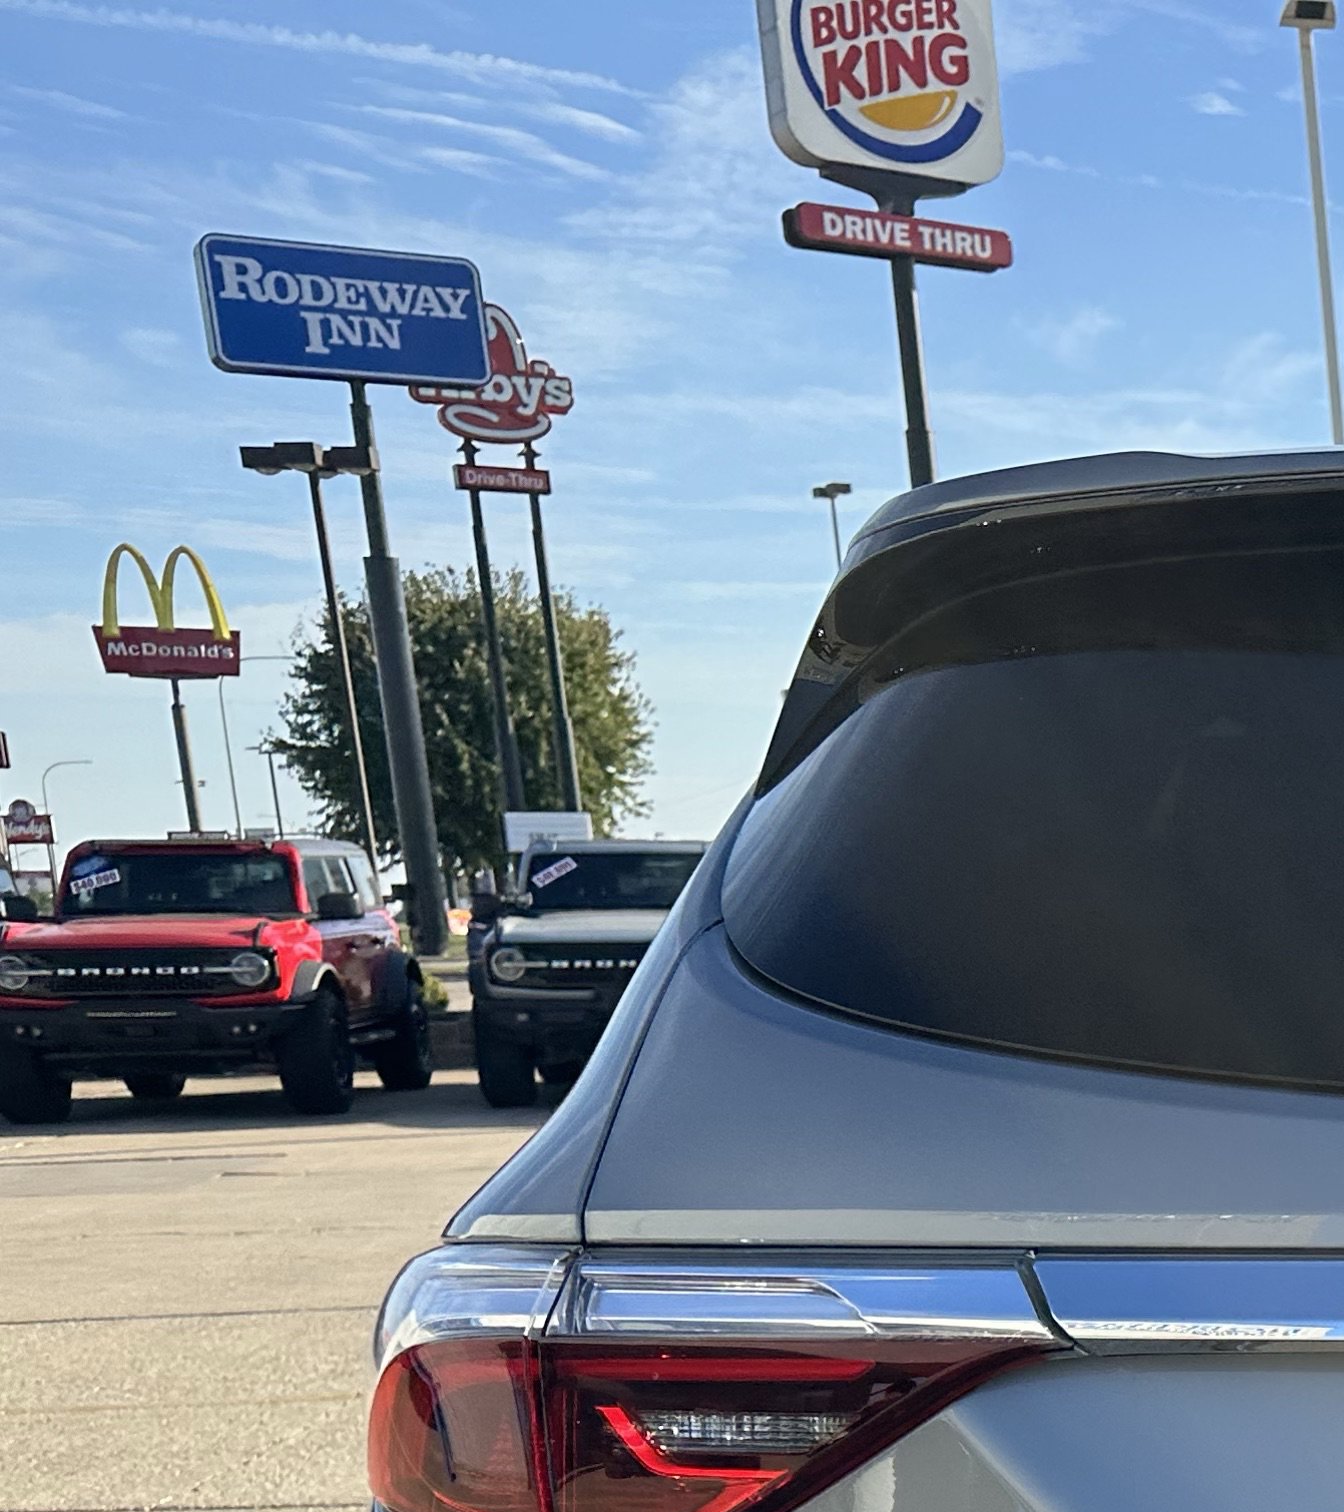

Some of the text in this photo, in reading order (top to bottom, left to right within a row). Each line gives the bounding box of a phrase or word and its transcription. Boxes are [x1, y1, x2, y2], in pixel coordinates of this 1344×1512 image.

[810, 0, 960, 48] BURGER
[822, 33, 969, 107] KING
[822, 211, 992, 258] DRIVE THRU
[213, 254, 471, 320] RODEWAY
[301, 310, 401, 355] INN
[417, 362, 574, 417] by's
[465, 470, 544, 489] Drive-Thru
[106, 641, 235, 661] McDonald's
